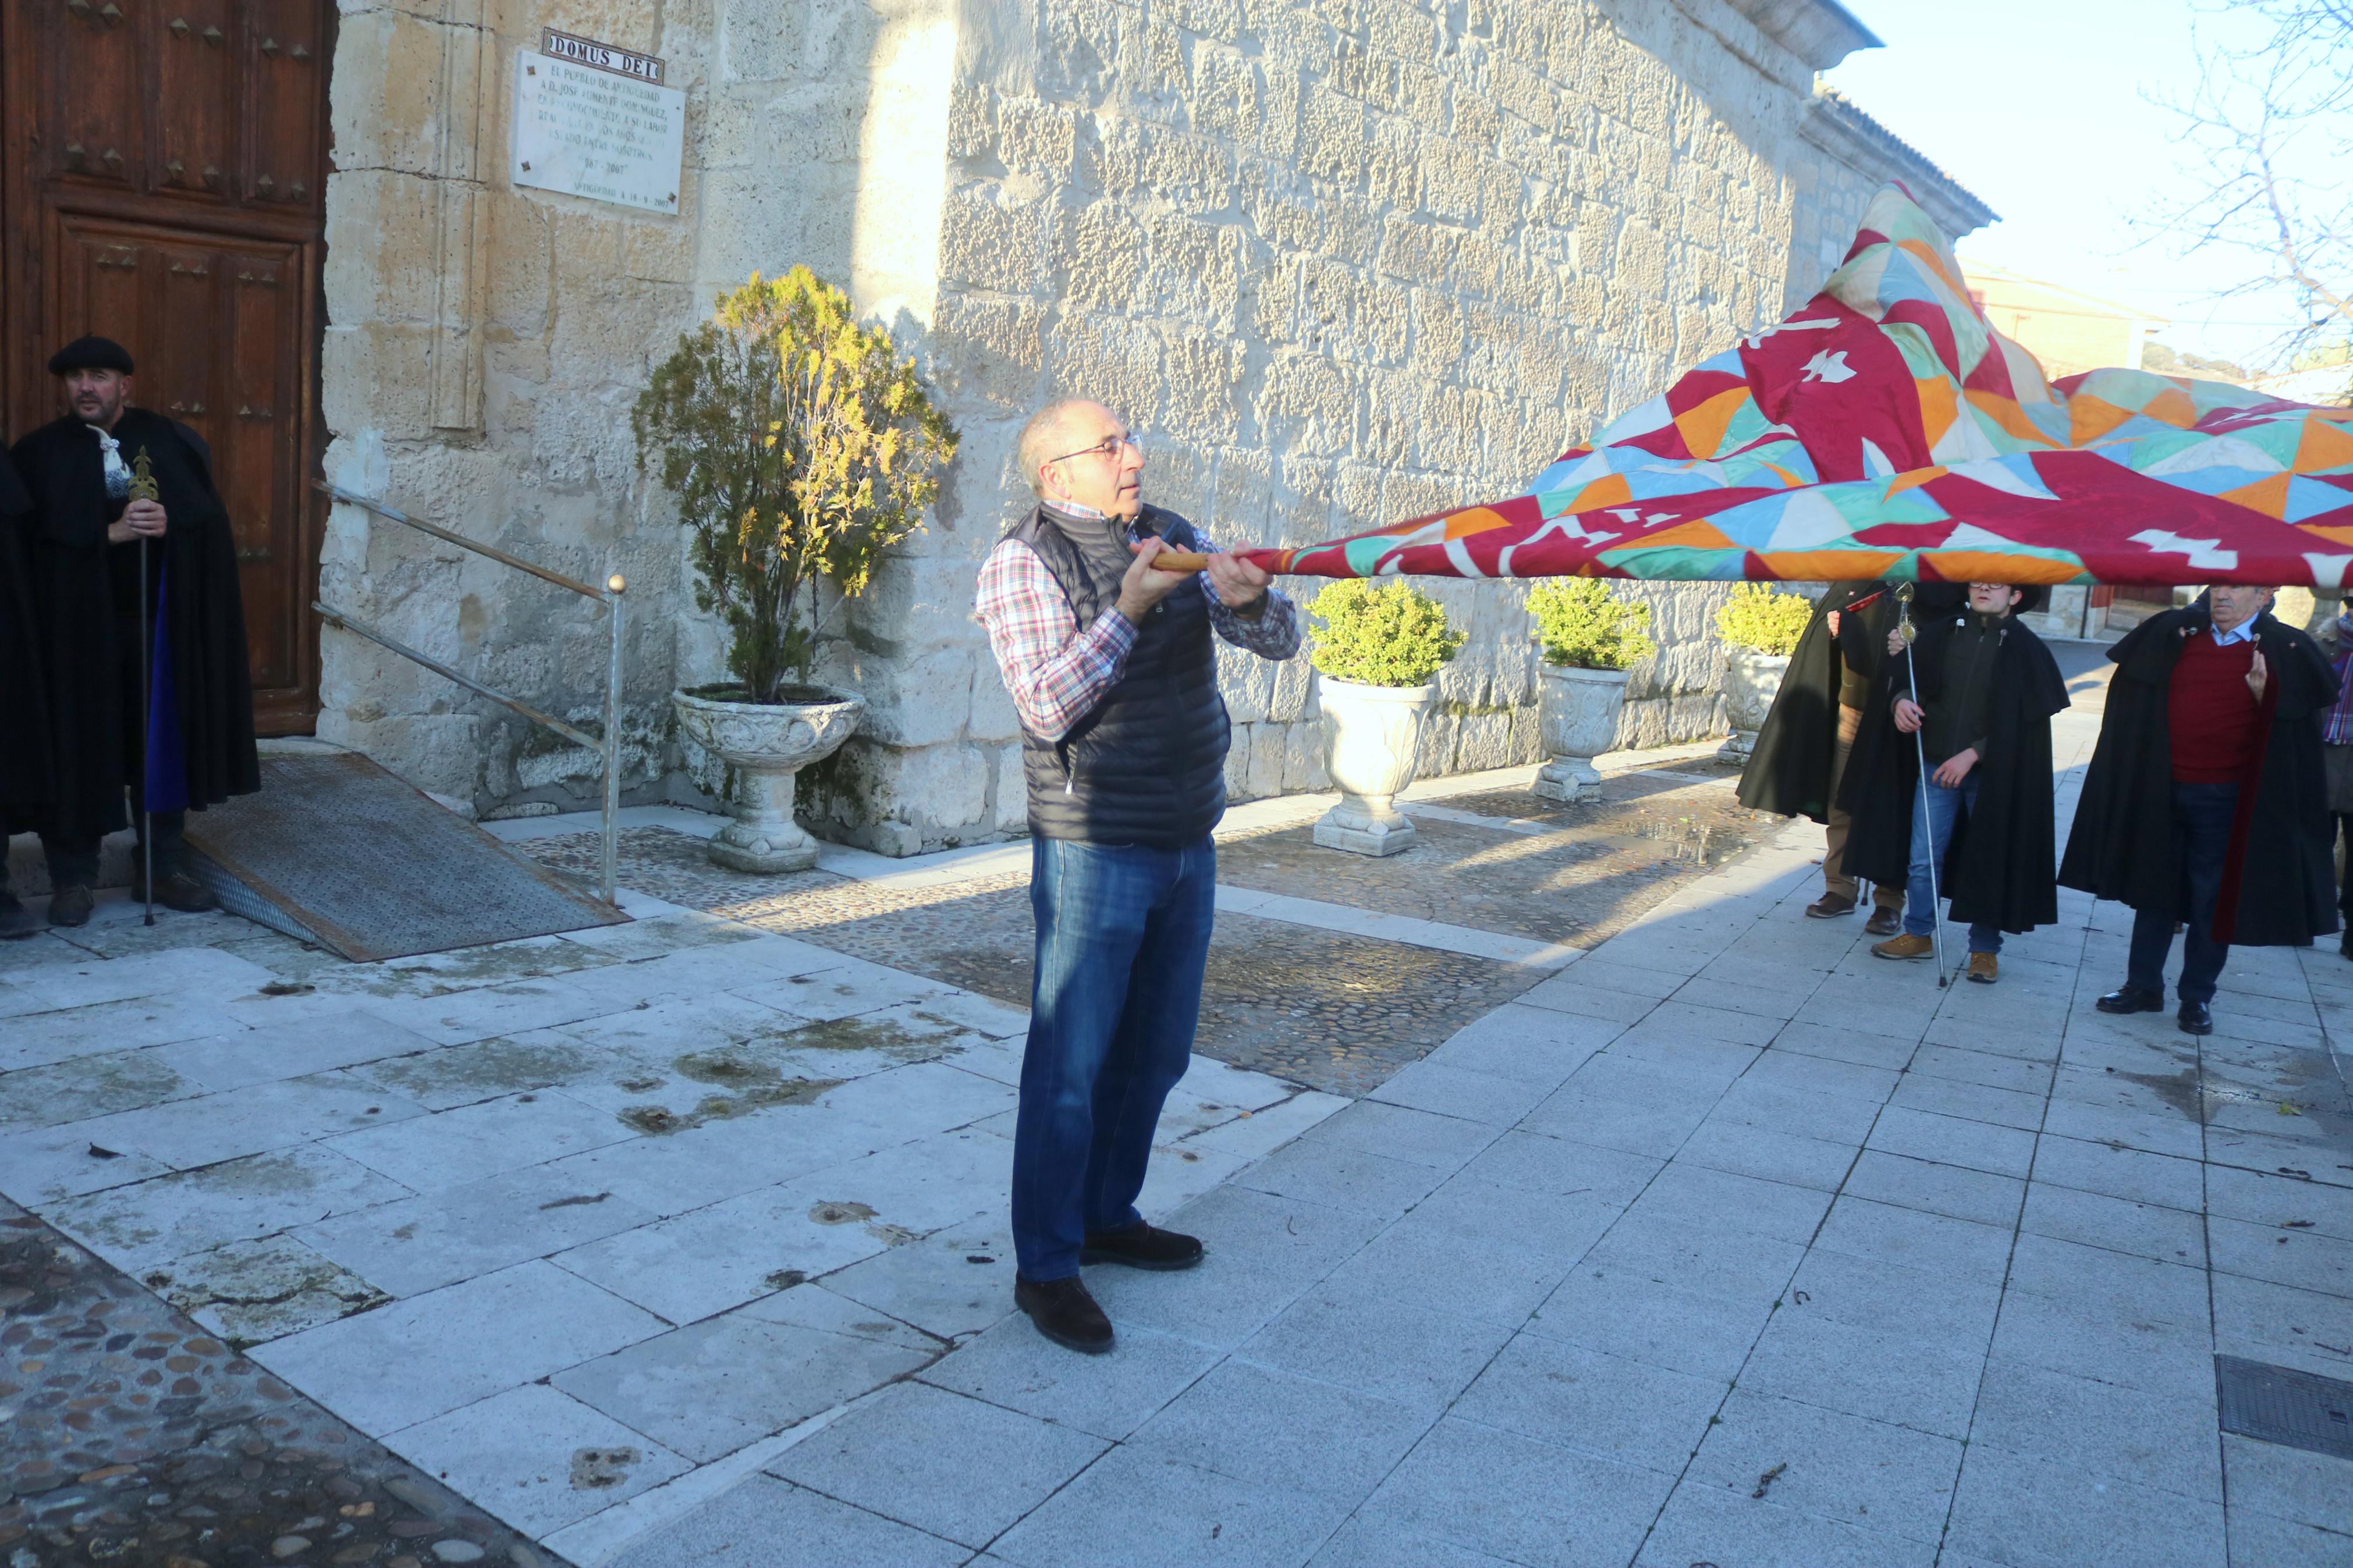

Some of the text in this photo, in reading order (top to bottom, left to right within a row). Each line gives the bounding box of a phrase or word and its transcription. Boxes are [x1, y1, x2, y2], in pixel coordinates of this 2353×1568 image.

[555, 37, 652, 77] DOMUS DEI
[564, 68, 595, 86] PUEBLO
[598, 77, 609, 89] DE
[541, 79, 546, 89] A
[549, 81, 558, 93] D.
[623, 115, 629, 125] A
[584, 136, 608, 151] ENTRE
[620, 191, 624, 199] A
